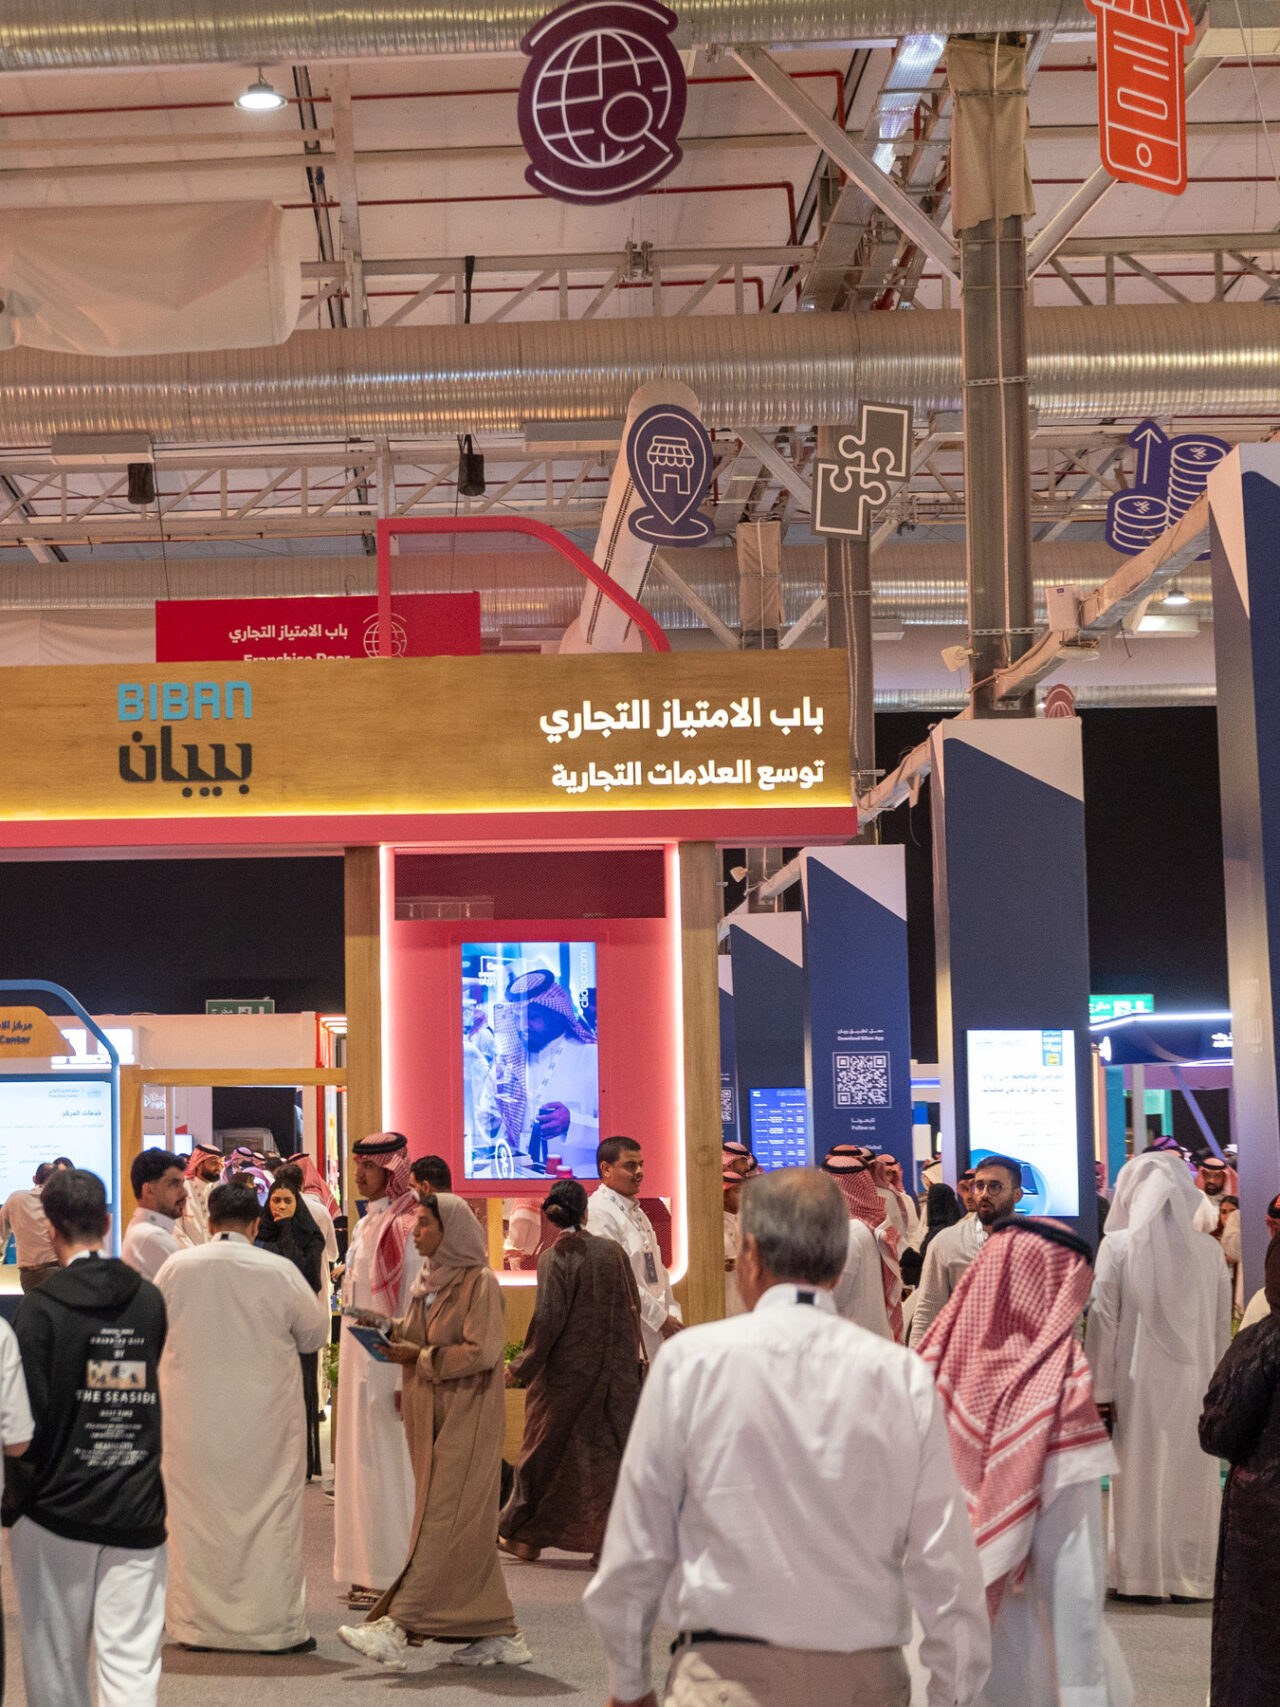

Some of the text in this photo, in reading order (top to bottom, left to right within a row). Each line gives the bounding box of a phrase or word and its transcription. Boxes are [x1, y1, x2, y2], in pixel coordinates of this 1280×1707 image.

[228, 623, 348, 644] باب الامتياز التجاري
[118, 681, 253, 721] BIBAN
[539, 696, 824, 744] باب الامتياز التجاري
[119, 725, 253, 798] بيبان
[551, 759, 825, 794] توسع العلامات التجارية
[0, 1034, 31, 1045] Center
[75, 1389, 158, 1406] THE SEASIDE
